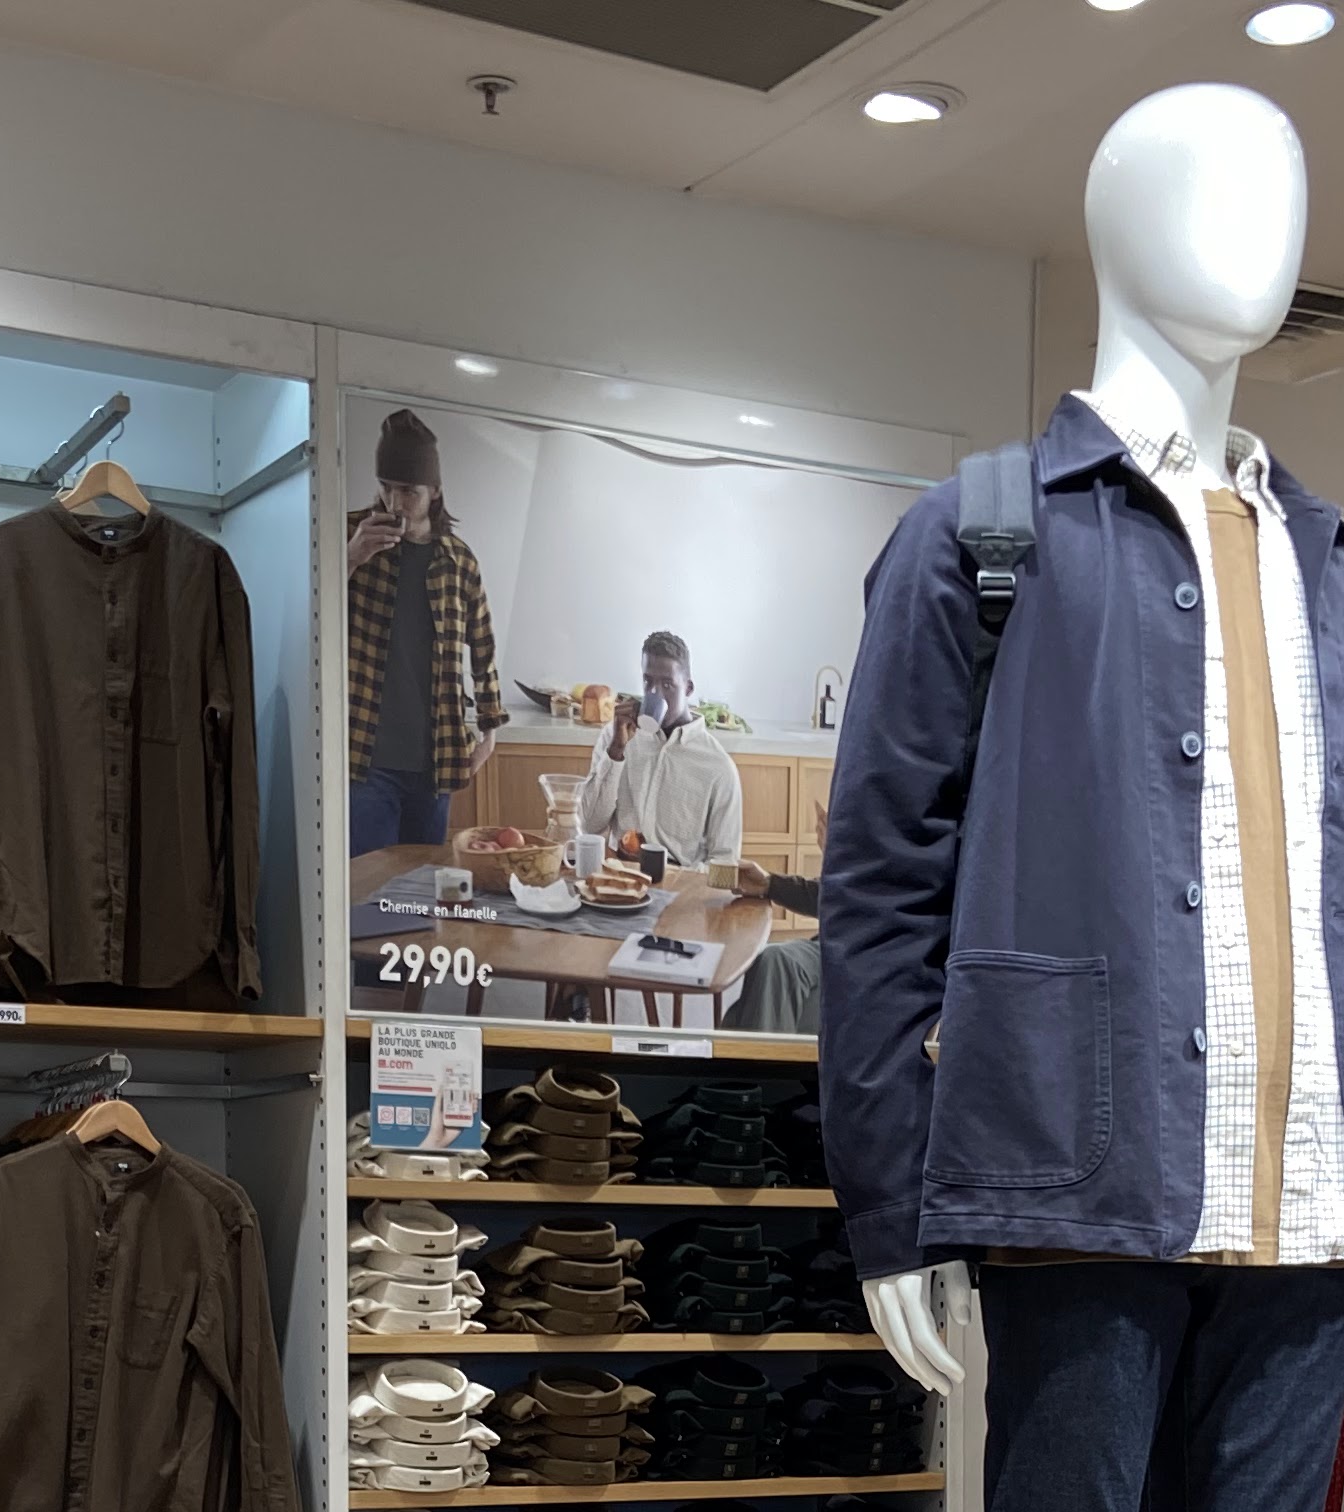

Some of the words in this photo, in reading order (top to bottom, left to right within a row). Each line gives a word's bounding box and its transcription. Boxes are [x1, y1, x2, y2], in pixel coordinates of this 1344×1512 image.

[379, 899, 428, 915] Chemise
[434, 906, 448, 916] en
[454, 904, 497, 920] flanelle
[379, 942, 493, 988] 29,90€
[378, 1026, 390, 1036] LA
[395, 1027, 417, 1037] PLUS
[421, 1030, 456, 1040] GRANDE
[378, 1037, 421, 1048] BOUTIQUE
[425, 1040, 456, 1050] UNIQLO
[378, 1047, 390, 1056] AU
[394, 1048, 424, 1058] MONDE
